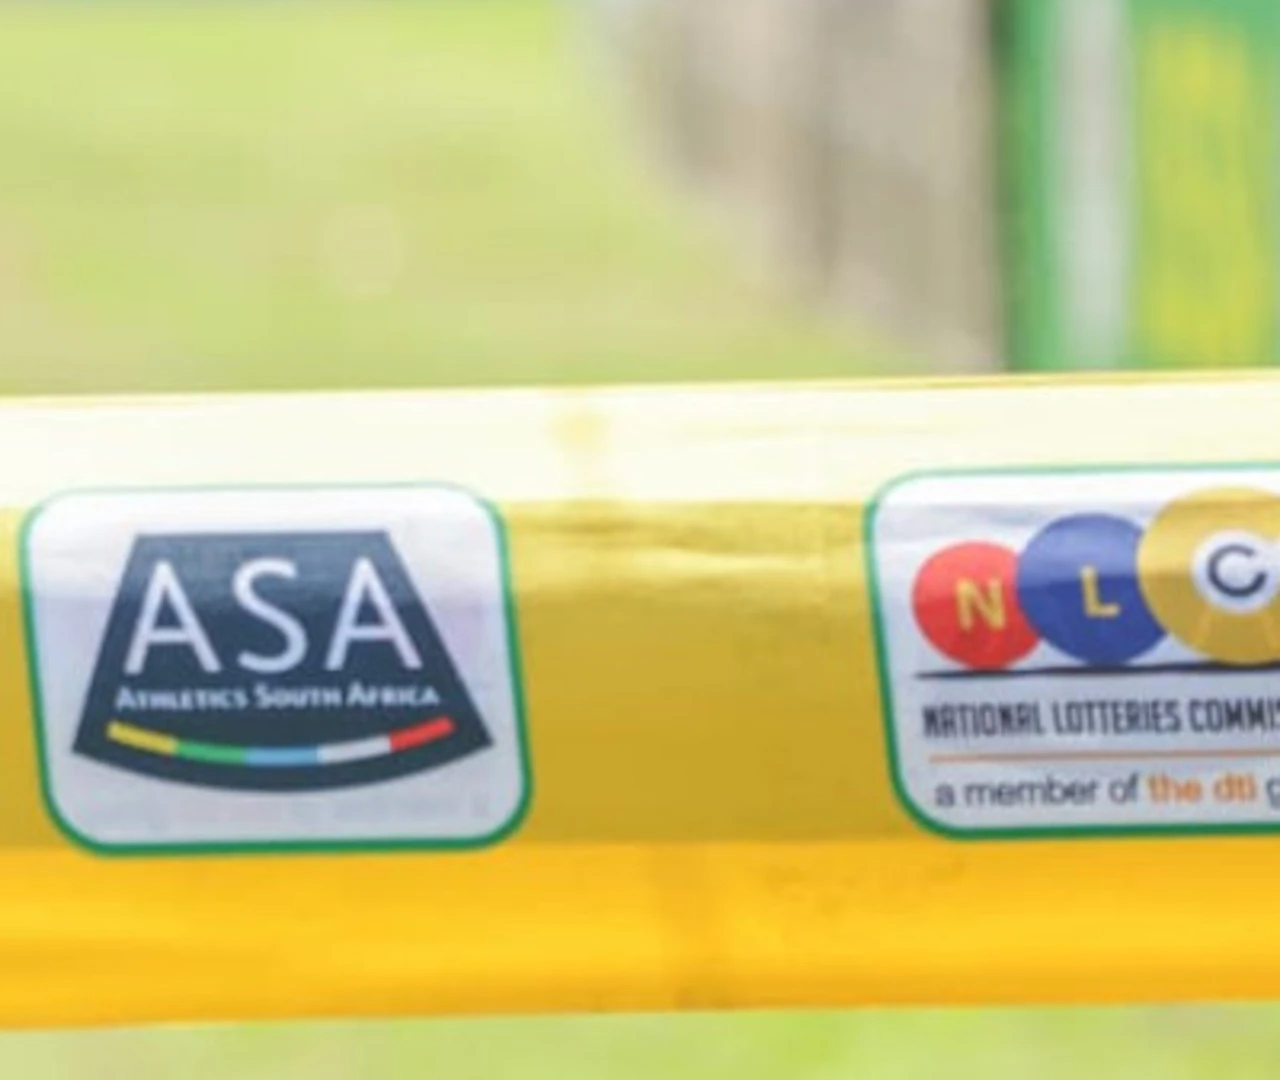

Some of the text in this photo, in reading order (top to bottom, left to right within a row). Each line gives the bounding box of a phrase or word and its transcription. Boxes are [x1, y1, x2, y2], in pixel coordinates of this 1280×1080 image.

[123, 557, 423, 674] ASA
[923, 701, 1044, 739] NATIONAL
[1053, 700, 1182, 735] LOTTERIES
[935, 782, 955, 807] a
[965, 774, 1100, 806] member
[1109, 772, 1141, 804] of
[1146, 771, 1202, 803] the
